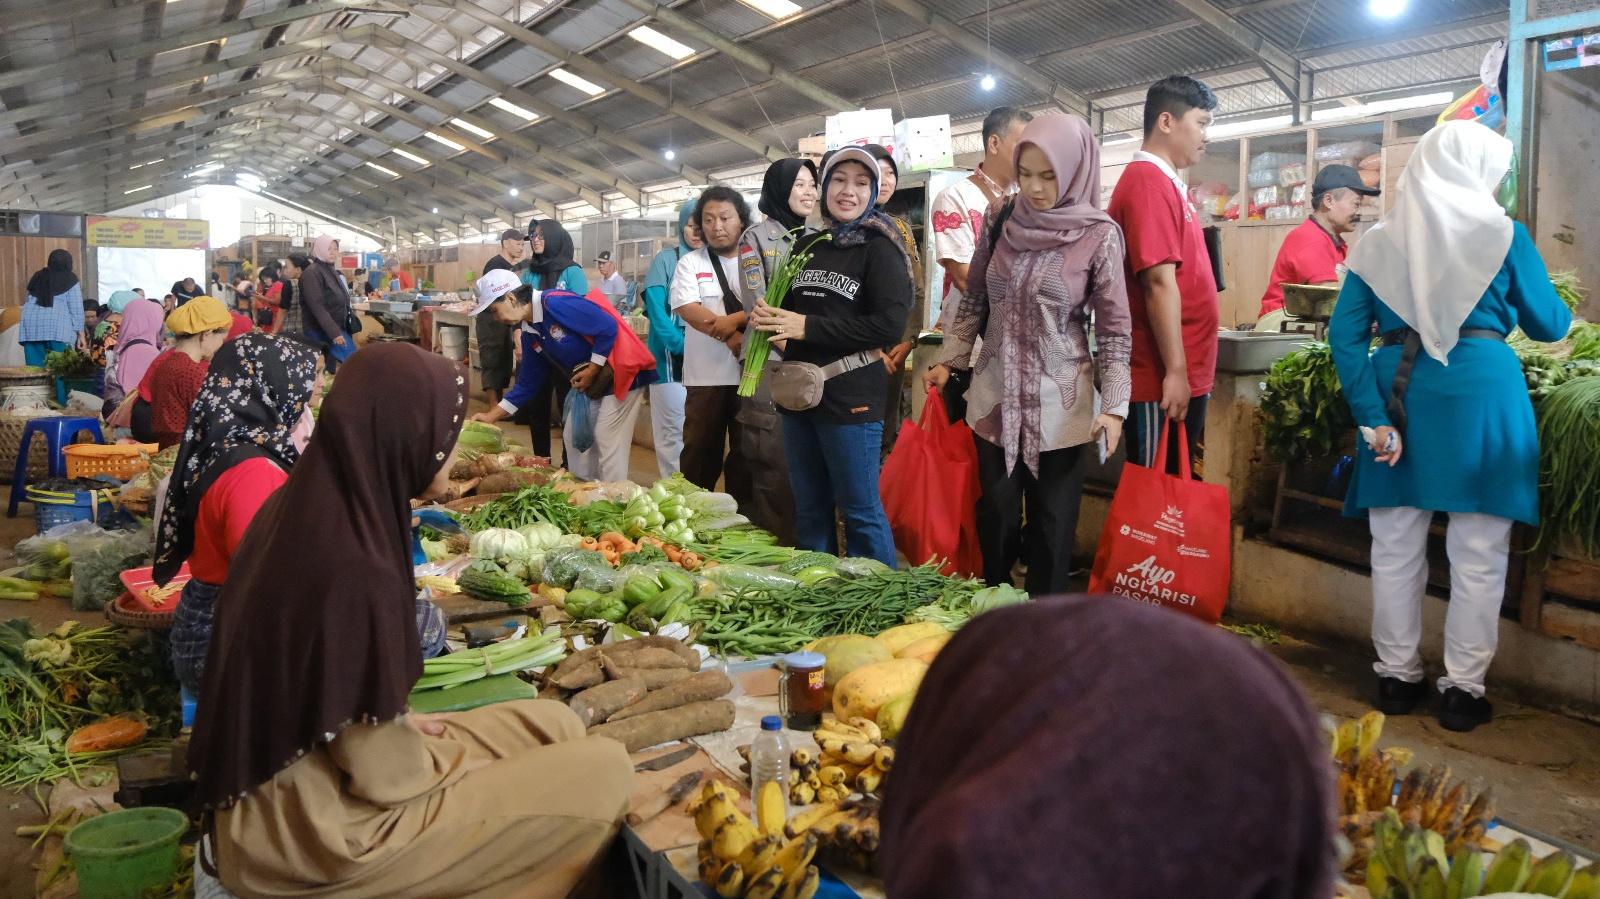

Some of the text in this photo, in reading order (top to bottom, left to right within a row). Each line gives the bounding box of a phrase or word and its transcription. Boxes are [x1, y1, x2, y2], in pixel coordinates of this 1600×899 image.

[795, 270, 860, 296] AGELANG
[1127, 555, 1175, 585] Ayo
[1115, 572, 1196, 606] NGLARISI
